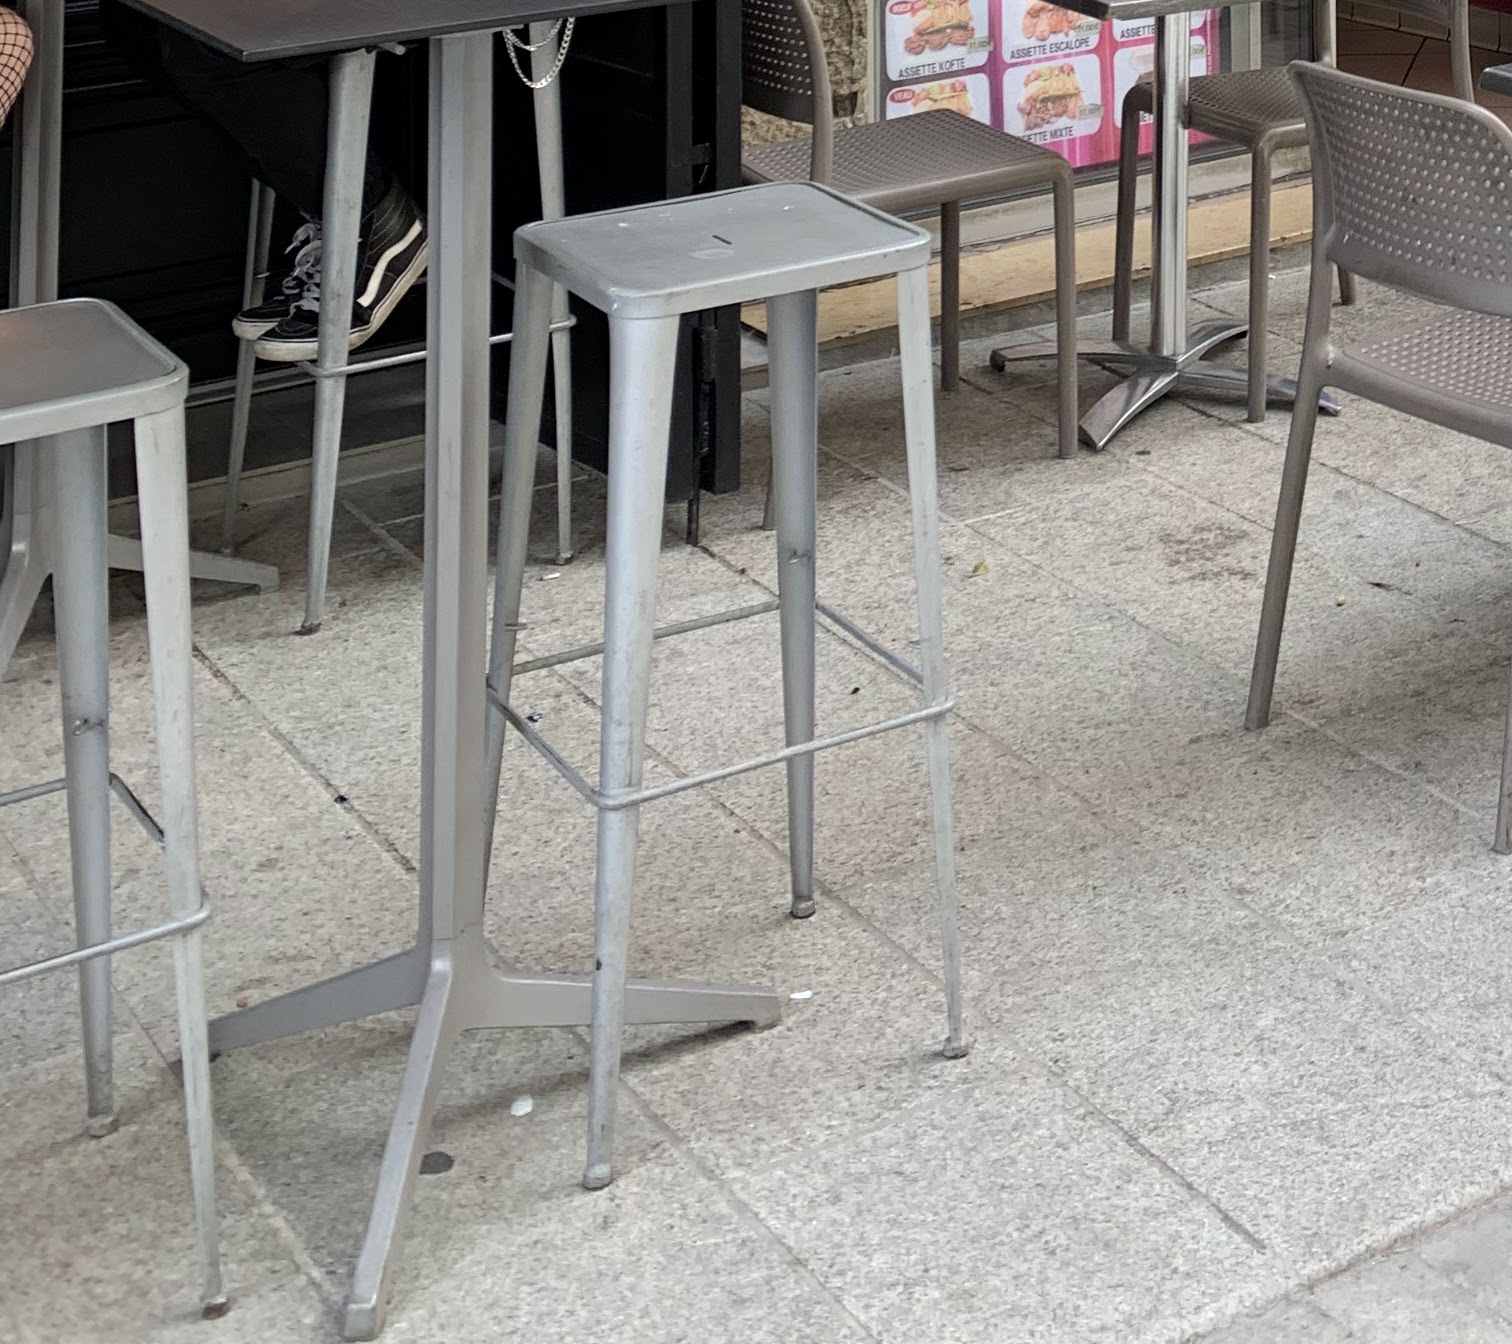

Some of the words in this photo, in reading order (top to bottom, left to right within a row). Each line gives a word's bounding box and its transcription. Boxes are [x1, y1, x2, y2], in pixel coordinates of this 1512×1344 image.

[1010, 44, 1048, 60] ASSIETTE
[1049, 37, 1090, 53] ESCALOPE
[899, 62, 937, 79] ASSIETTE
[938, 57, 966, 72] KOFTE
[1049, 126, 1074, 140] MIXTE
